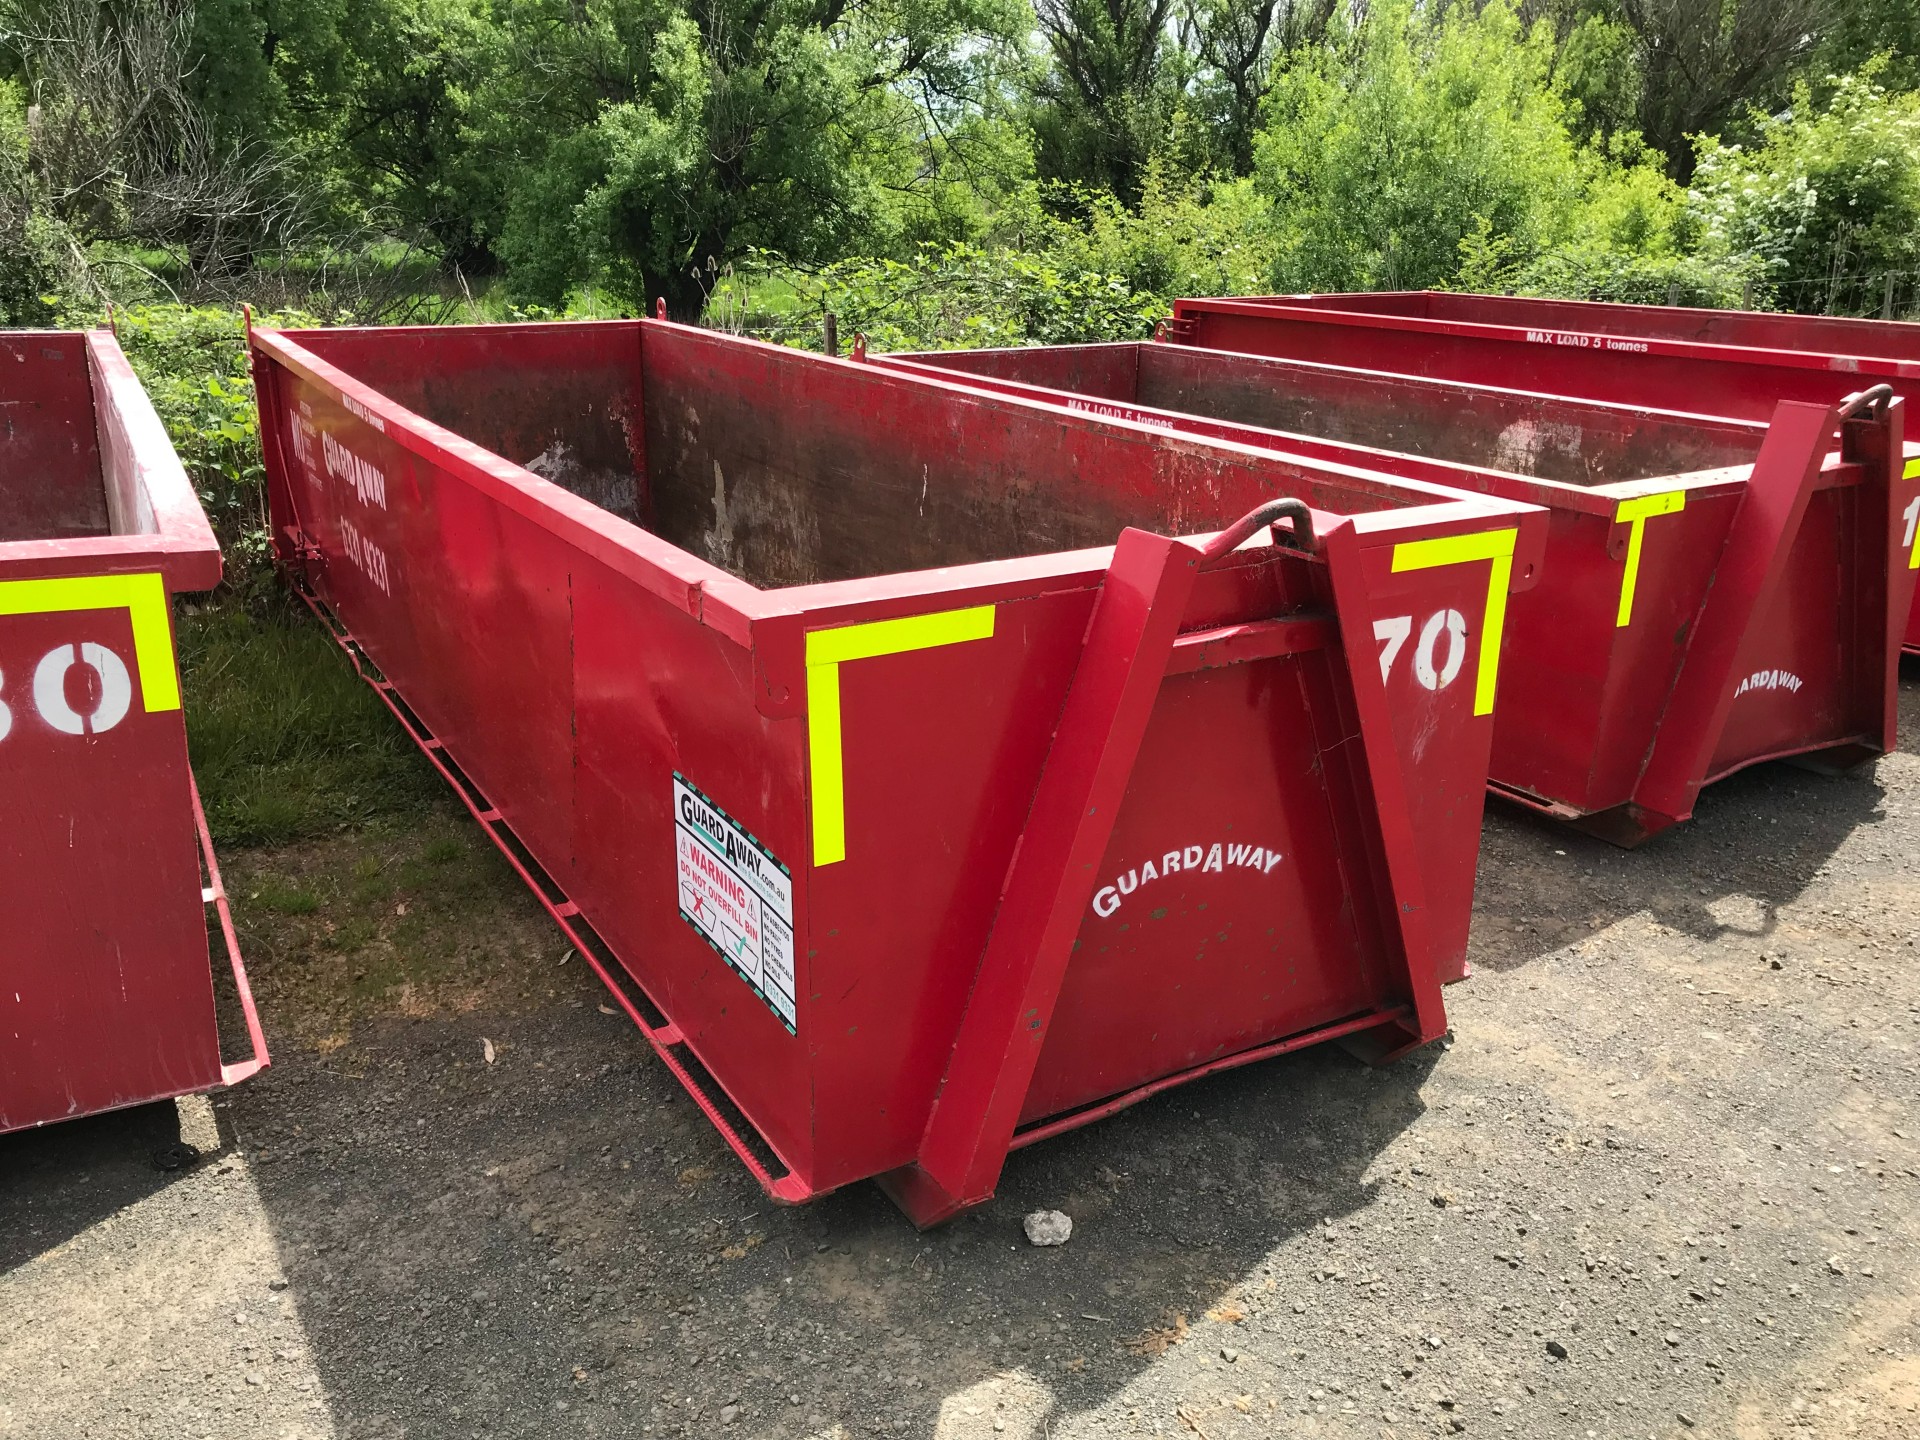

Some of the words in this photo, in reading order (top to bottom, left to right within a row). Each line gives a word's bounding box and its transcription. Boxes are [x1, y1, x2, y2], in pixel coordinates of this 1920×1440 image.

[1527, 331, 1553, 343] MAX
[1557, 335, 1589, 347] LOAD
[1593, 338, 1601, 348] 5
[1607, 338, 1648, 352] tonnes
[1068, 399, 1091, 413] MAX
[1094, 405, 1121, 419] LOAD
[1125, 411, 1132, 421] 5
[1137, 413, 1174, 430] tonnes
[341, 514, 363, 572] 6331
[363, 535, 391, 598] 9331
[1373, 609, 1466, 690] 70
[1734, 669, 1803, 699] ARDAWAY
[0, 642, 131, 742] 0
[681, 859, 691, 877] DO
[692, 870, 706, 892] NOT
[708, 885, 743, 928] OVERFILL
[745, 919, 758, 943] BIN
[690, 842, 746, 909] WARNING
[1092, 843, 1283, 918] GUARDAWAY
